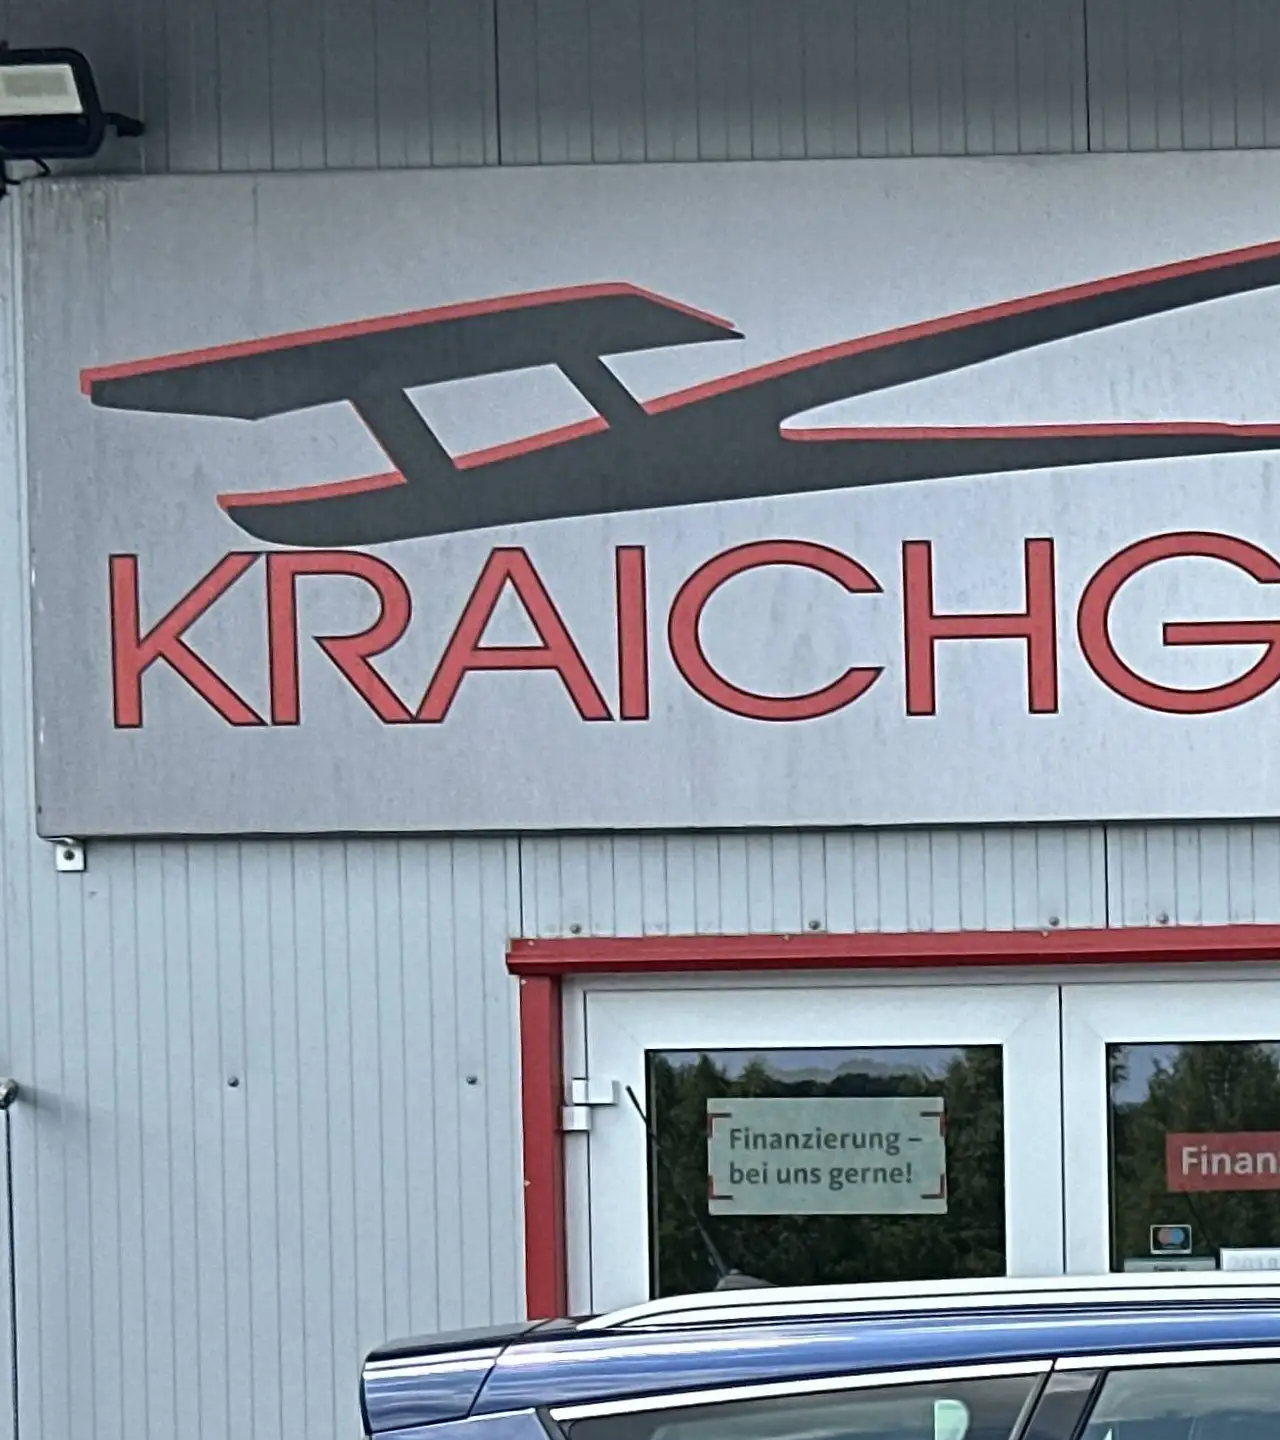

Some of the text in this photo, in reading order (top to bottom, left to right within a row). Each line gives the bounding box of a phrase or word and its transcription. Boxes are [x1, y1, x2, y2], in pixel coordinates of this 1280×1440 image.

[728, 1127, 901, 1156] Finanzierung
[728, 1161, 913, 1192] bei uns gerne!
